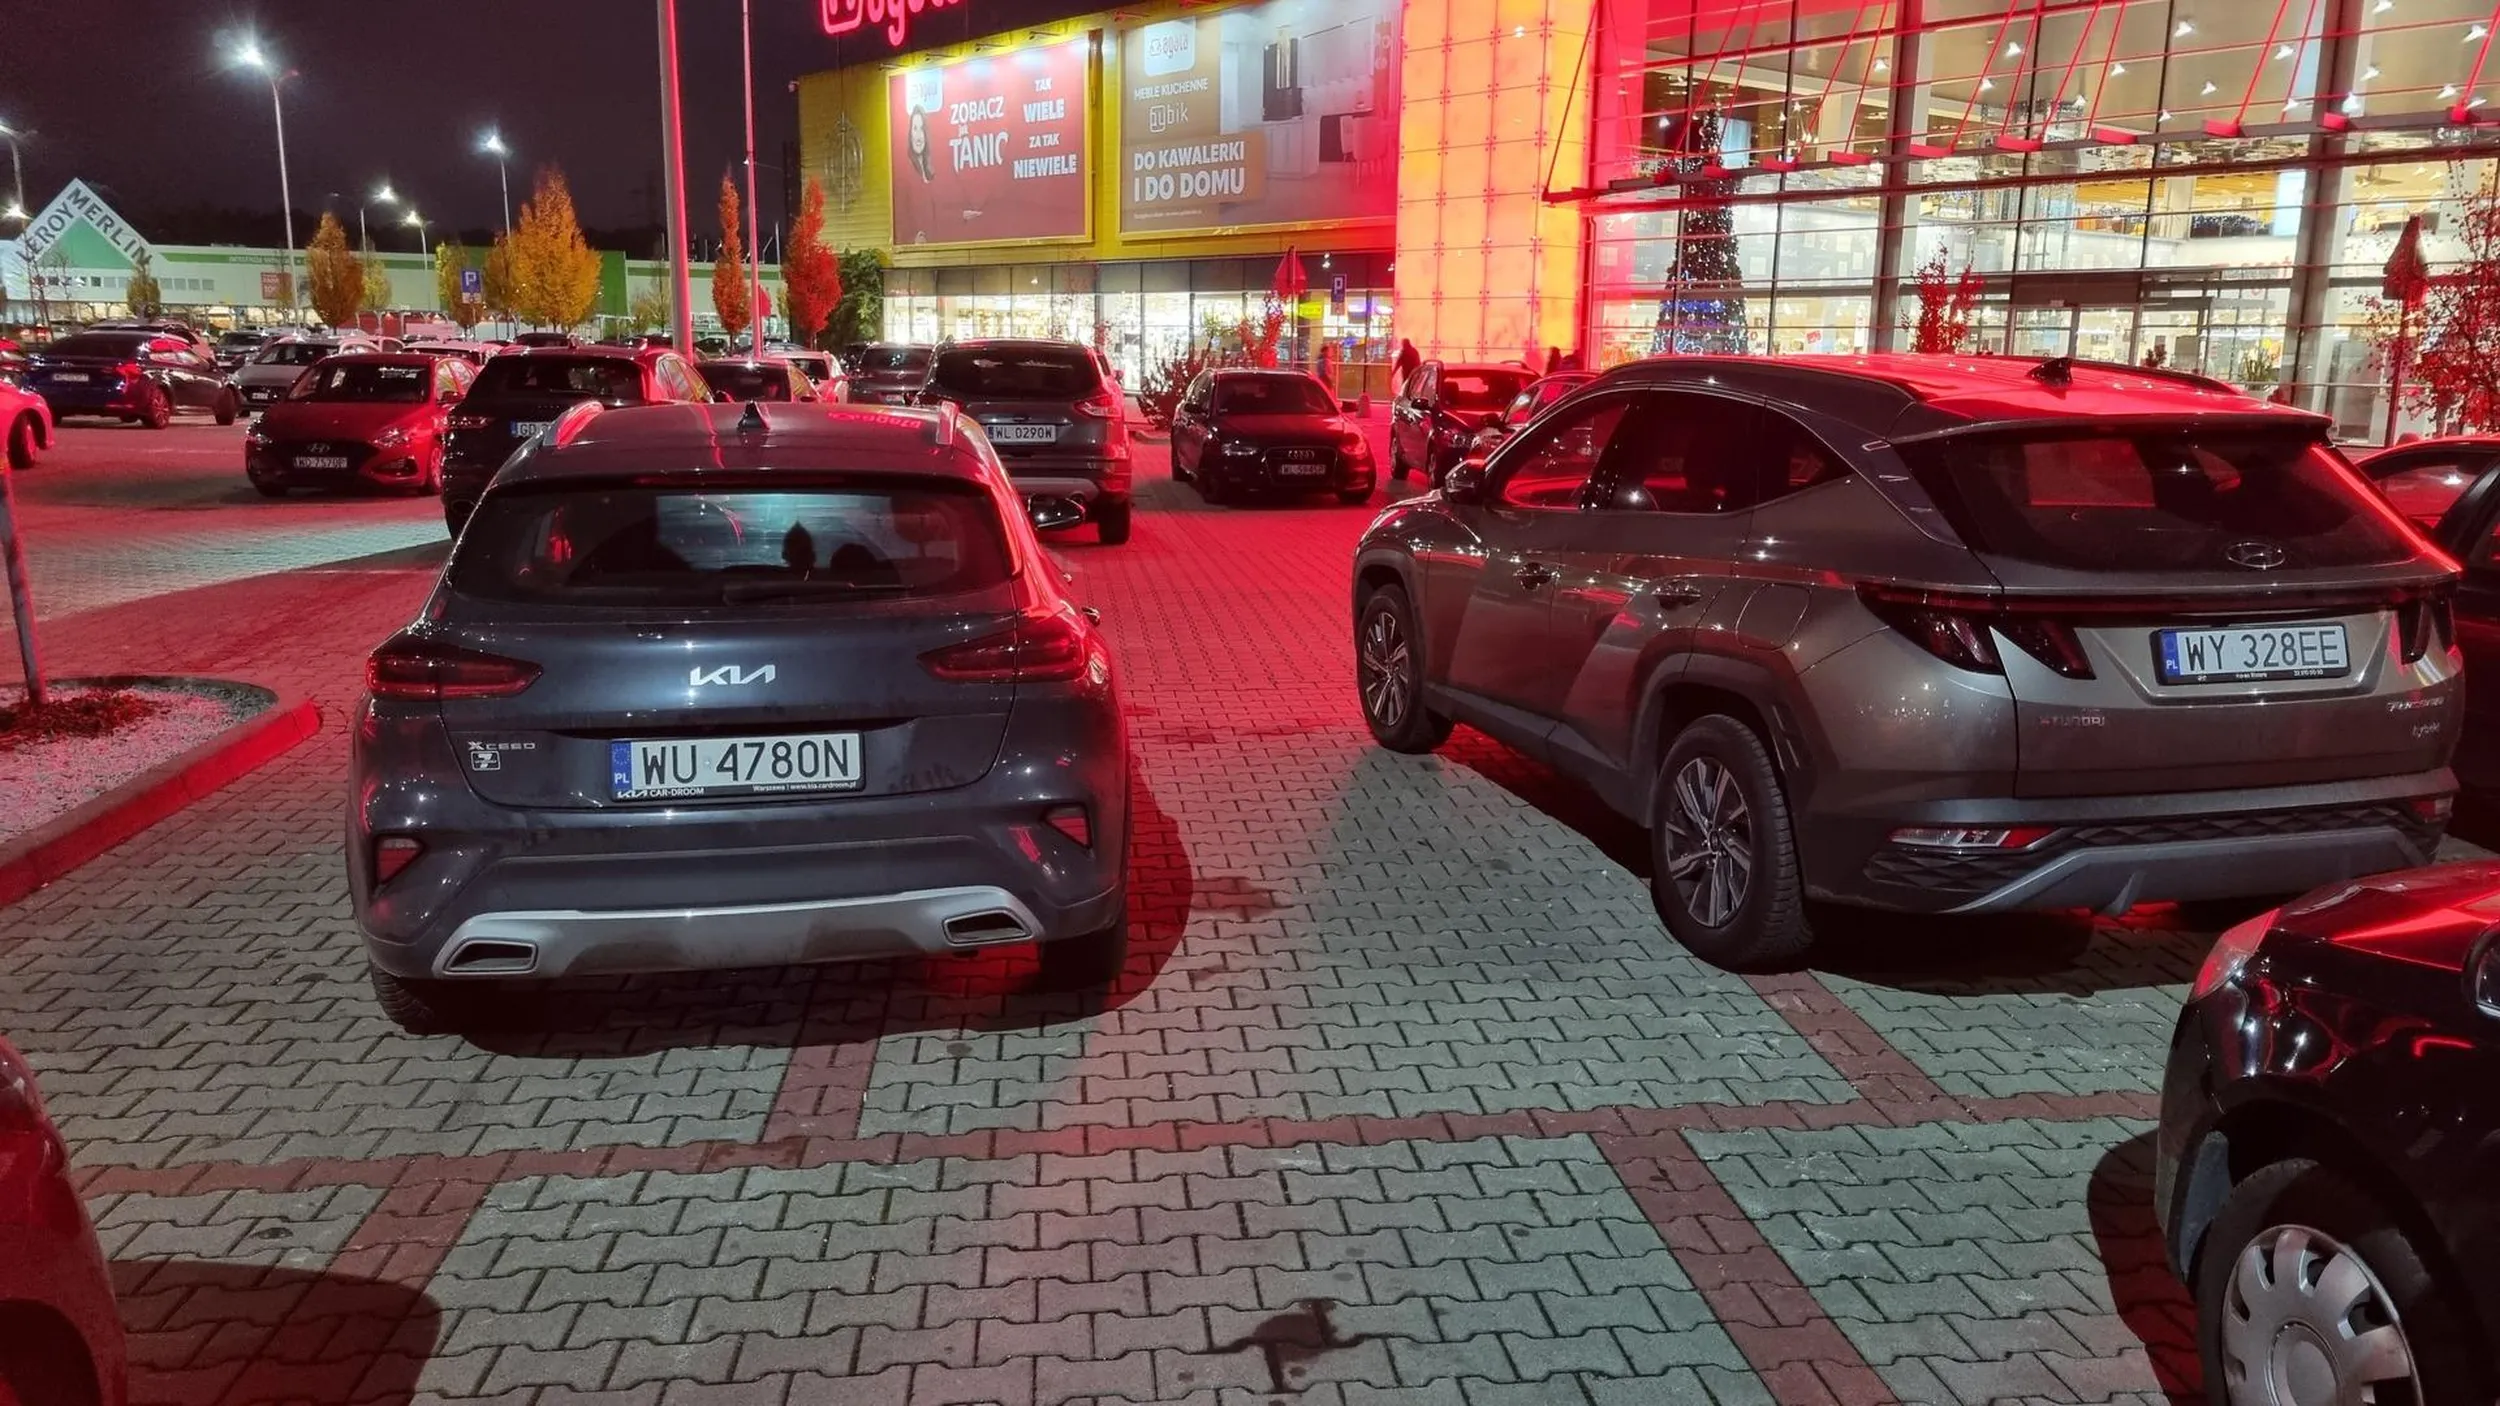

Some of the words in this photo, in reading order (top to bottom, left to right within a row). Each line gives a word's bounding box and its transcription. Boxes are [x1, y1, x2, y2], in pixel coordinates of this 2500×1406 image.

[950, 95, 1004, 125] ZOBACZ
[1023, 98, 1064, 123] WIELE
[1029, 135, 1041, 149] ZA
[1042, 132, 1060, 147] TAK
[1013, 154, 1076, 179] NIEWIELE
[1134, 151, 1155, 171] DO
[1159, 141, 1244, 168] KAWALERKI
[1134, 177, 1141, 202] I
[1145, 173, 1175, 201] DO
[1180, 167, 1245, 198] DOMU
[16, 201, 74, 262] LEROY
[67, 187, 153, 269] MERLIN
[465, 271, 477, 286] P
[1334, 277, 1343, 294] P
[996, 427, 1011, 439] WL
[2186, 634, 2225, 672] WY
[2241, 630, 2340, 669] 328EE
[2166, 660, 2178, 670] PL
[642, 745, 697, 785] WU
[716, 739, 849, 782] 4780N
[615, 773, 629, 784] PL
[649, 787, 704, 797] CAR-DROOM
